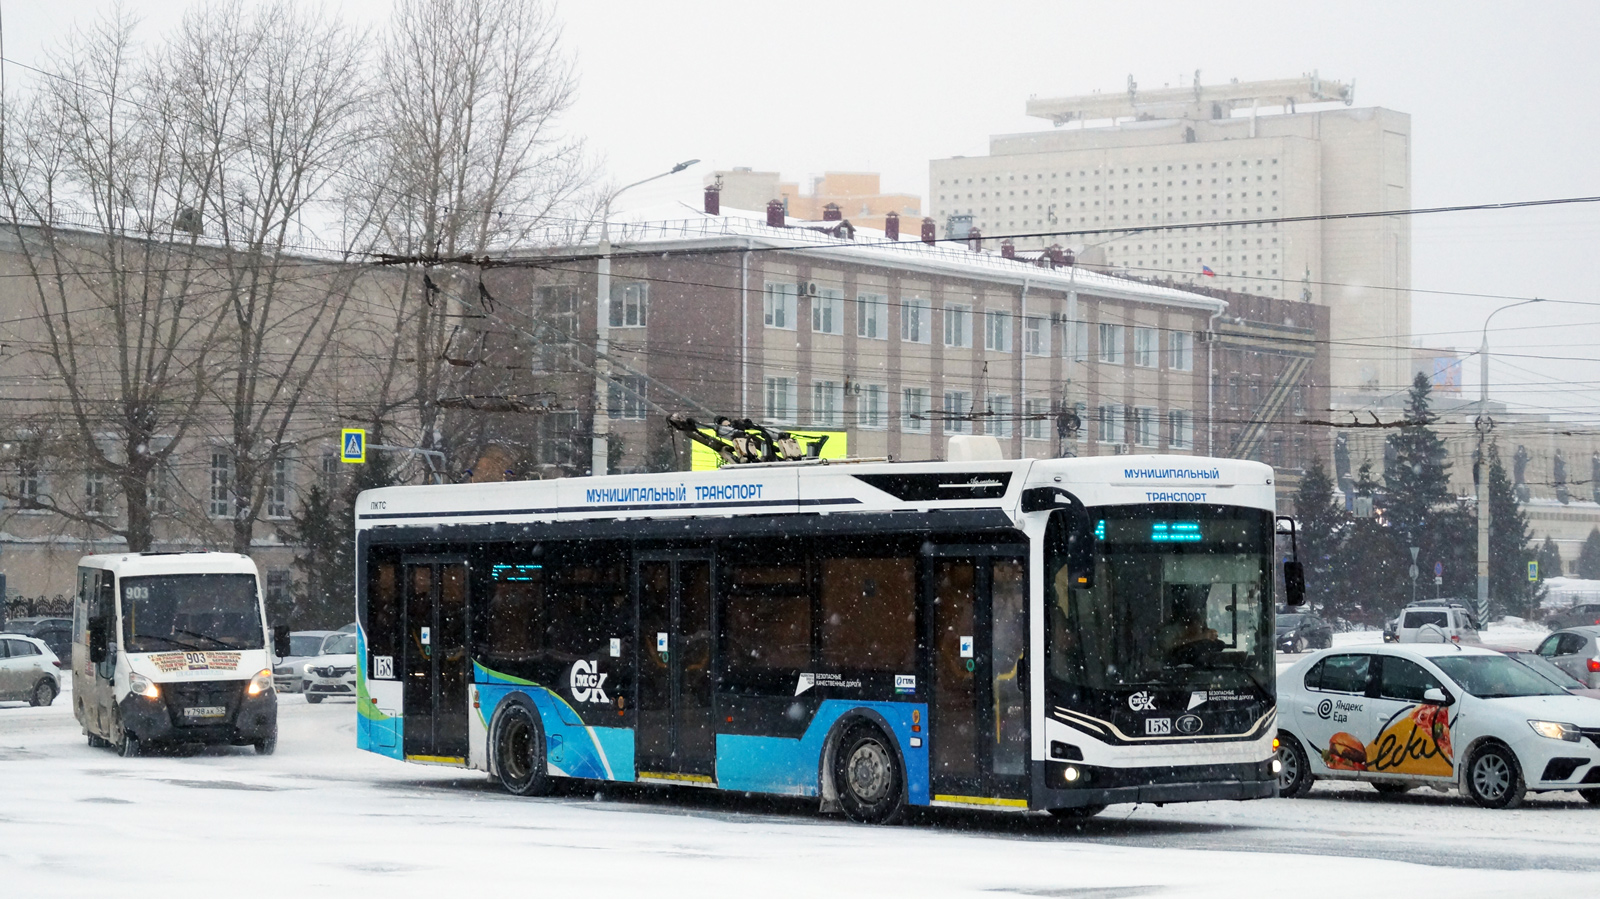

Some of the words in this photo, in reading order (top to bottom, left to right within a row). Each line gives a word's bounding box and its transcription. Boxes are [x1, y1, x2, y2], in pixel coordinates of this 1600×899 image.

[1124, 467, 1219, 479] МУНИЦИПАЛЬНЫЙ
[586, 483, 687, 503] МУНИЦИПАЛЬНЫЙ
[694, 483, 763, 501] ТРАНСПОРТ
[1145, 492, 1207, 502] ТРАНСПОРТ
[370, 500, 387, 510] ПКТС
[126, 586, 149, 599] 903
[186, 652, 206, 664] 903
[375, 658, 392, 678] 158
[846, 680, 862, 688] ДОРОГИ
[1335, 699, 1363, 713] Яндекс
[1333, 711, 1348, 724] Еда
[1147, 719, 1169, 733] 158
